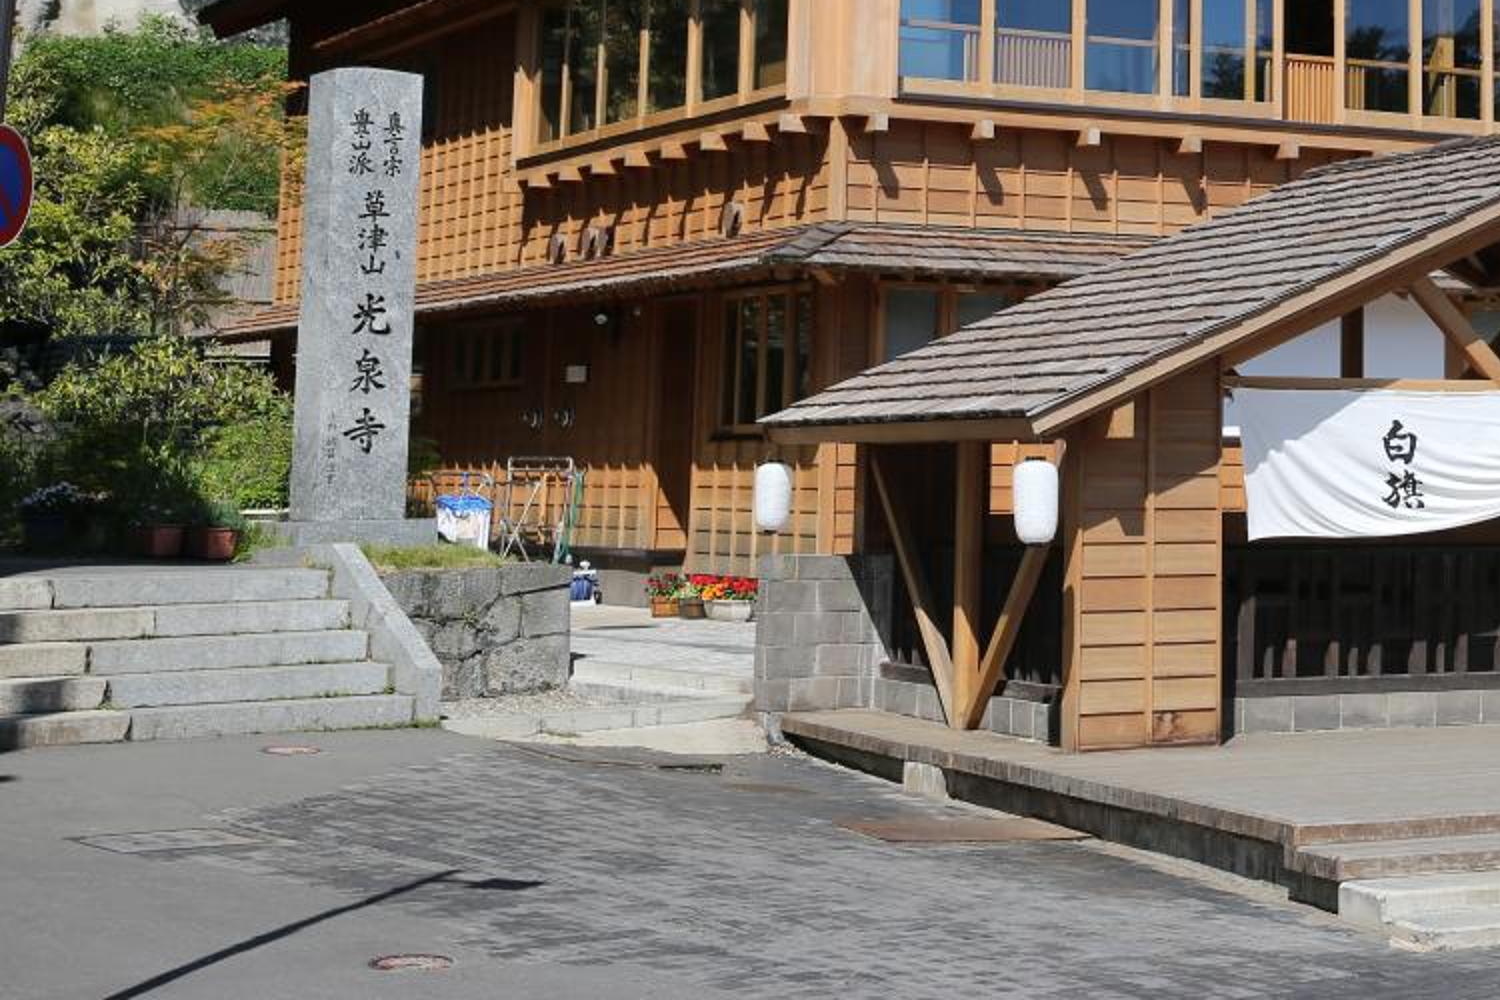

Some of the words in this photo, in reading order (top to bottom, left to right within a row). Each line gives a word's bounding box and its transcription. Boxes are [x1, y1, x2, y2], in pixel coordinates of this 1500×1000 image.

[383, 111, 405, 177] 真言宗
[1382, 419, 1425, 509] 白旗
